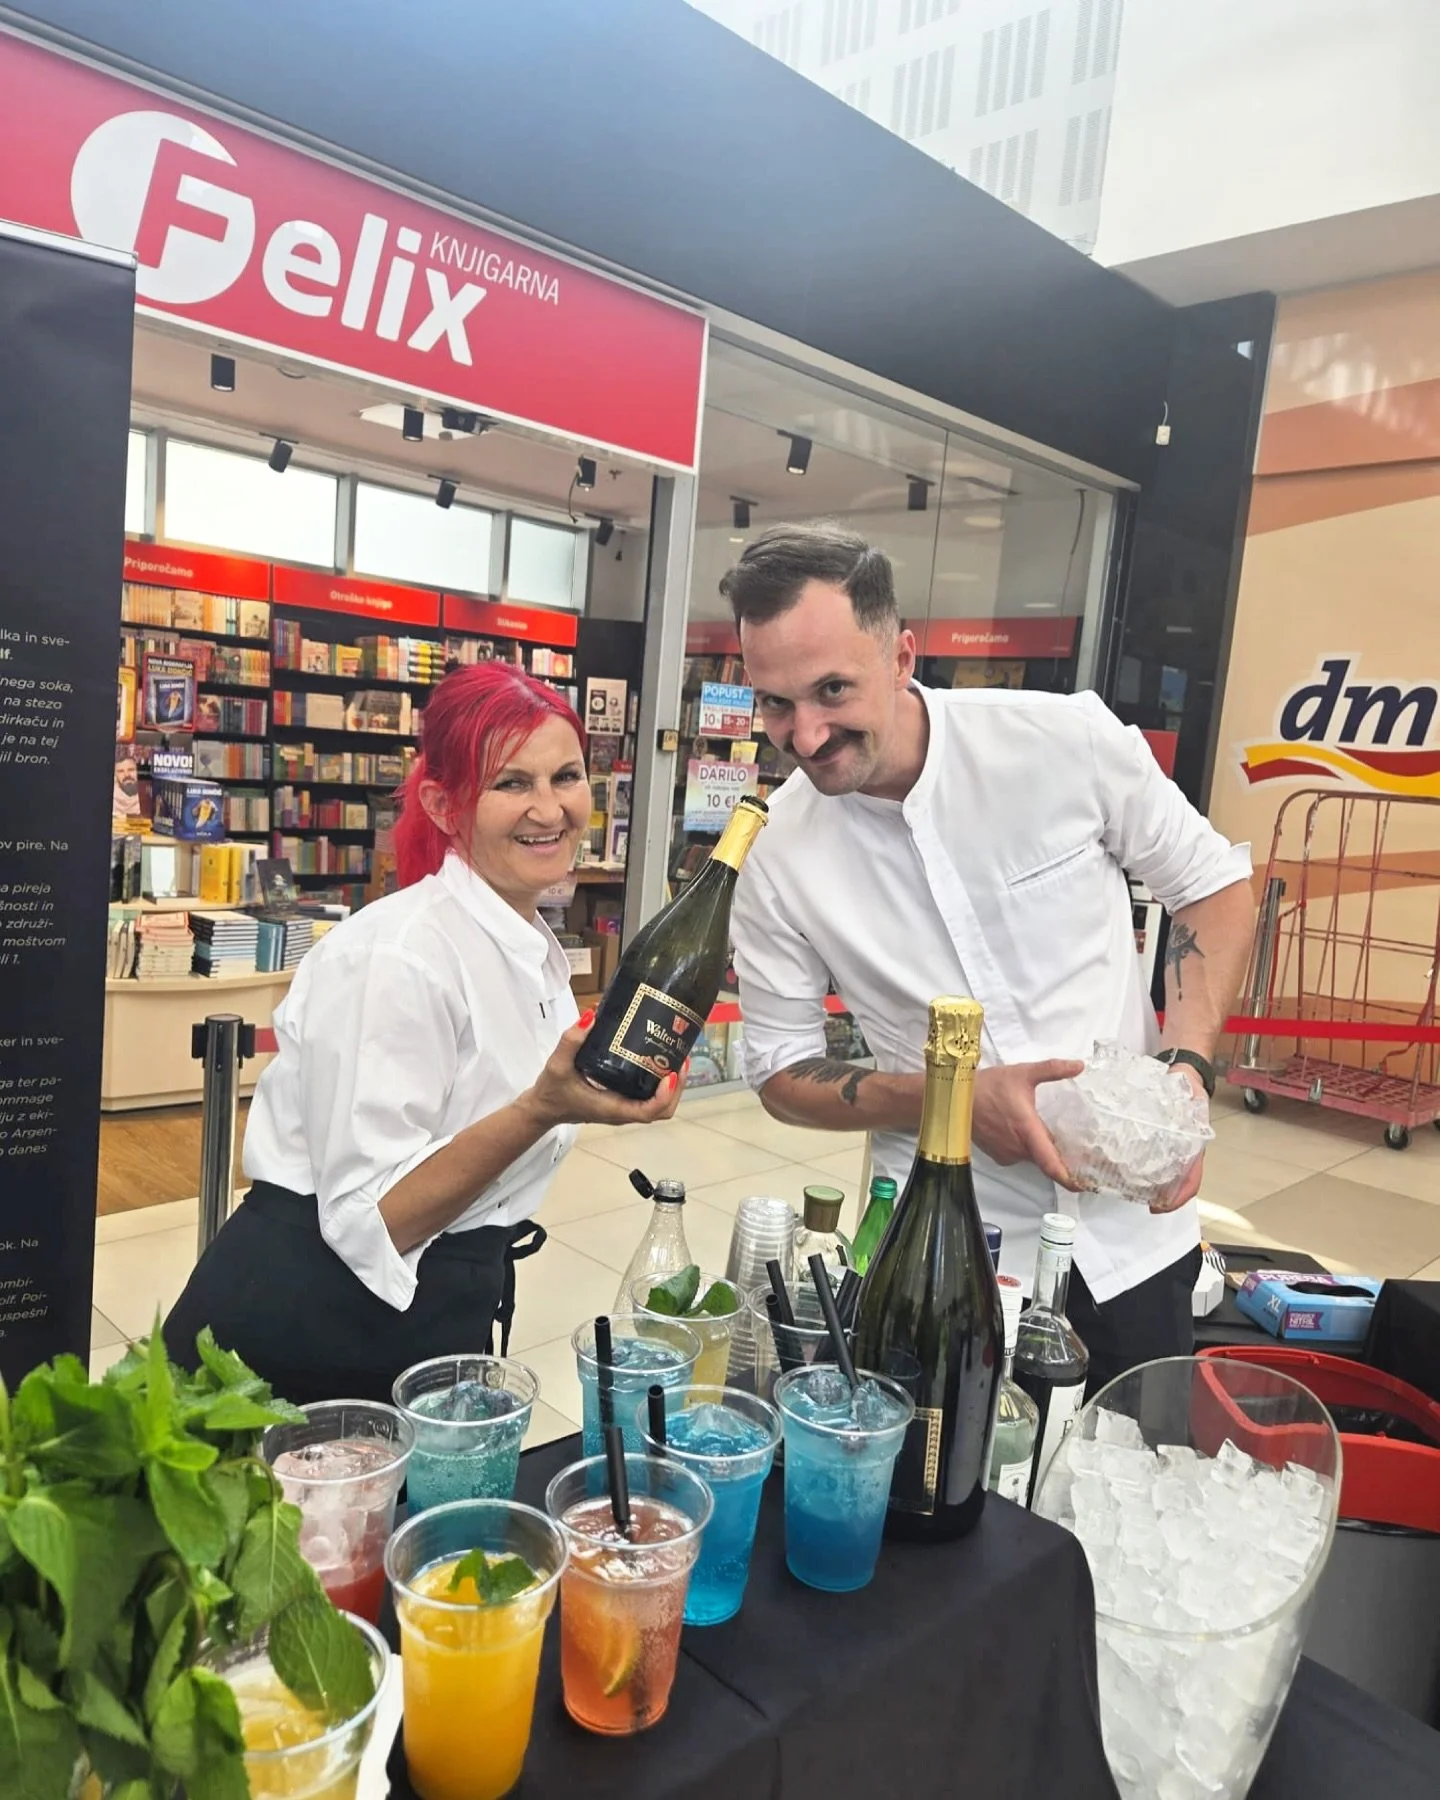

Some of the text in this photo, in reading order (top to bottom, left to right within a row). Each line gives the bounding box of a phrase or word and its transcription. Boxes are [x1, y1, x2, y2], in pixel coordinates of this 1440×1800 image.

[71, 110, 487, 366] Felix
[430, 231, 560, 306] KNJIGARNA
[25, 631, 37, 643] in
[41, 636, 70, 647] sve-
[40, 680, 74, 694] soka,
[704, 685, 744, 701] POPUST
[4, 697, 21, 706] na
[1280, 659, 1438, 747] dm
[52, 717, 65, 728] in
[1, 732, 60, 749] je na tej
[15, 752, 50, 765] bron.
[153, 753, 193, 768] NOVO!
[700, 767, 747, 782] DARILO
[707, 794, 720, 808] 10
[16, 840, 46, 851] pire.
[51, 840, 69, 850] Na
[41, 900, 54, 911] in
[2, 936, 66, 947] moštvom
[647, 1019, 676, 1047] Walter
[21, 1036, 33, 1047] in
[18, 1077, 38, 1088] ter
[11, 1128, 58, 1139] Argen-
[8, 1144, 48, 1156] danes
[20, 1238, 39, 1249] Na
